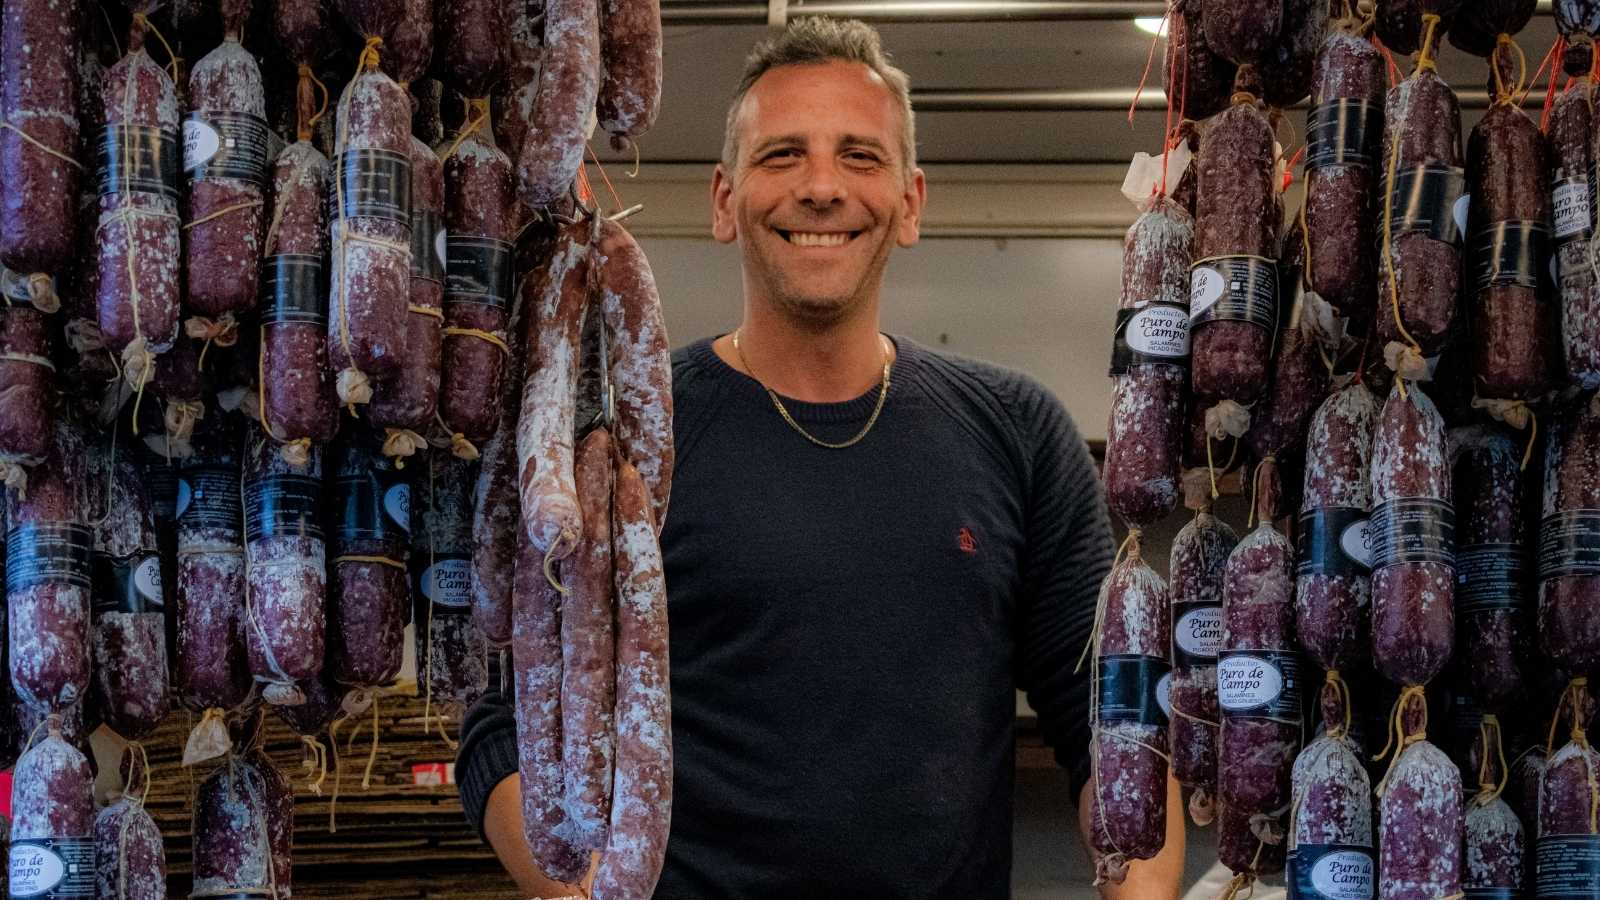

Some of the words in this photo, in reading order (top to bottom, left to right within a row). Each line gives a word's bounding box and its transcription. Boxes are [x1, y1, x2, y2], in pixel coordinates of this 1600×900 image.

[1554, 204, 1589, 220] ampo
[1140, 317, 1172, 328] Puro
[1176, 318, 1188, 331] de
[1143, 327, 1185, 342] Campo
[435, 568, 465, 580] Puro
[1189, 618, 1221, 629] Puro
[1220, 668, 1245, 680] Puro
[1248, 666, 1264, 679] de
[1221, 679, 1260, 693] Campo
[29, 853, 44, 866] de
[1329, 861, 1360, 874] Puro
[1332, 872, 1370, 889] Campo
